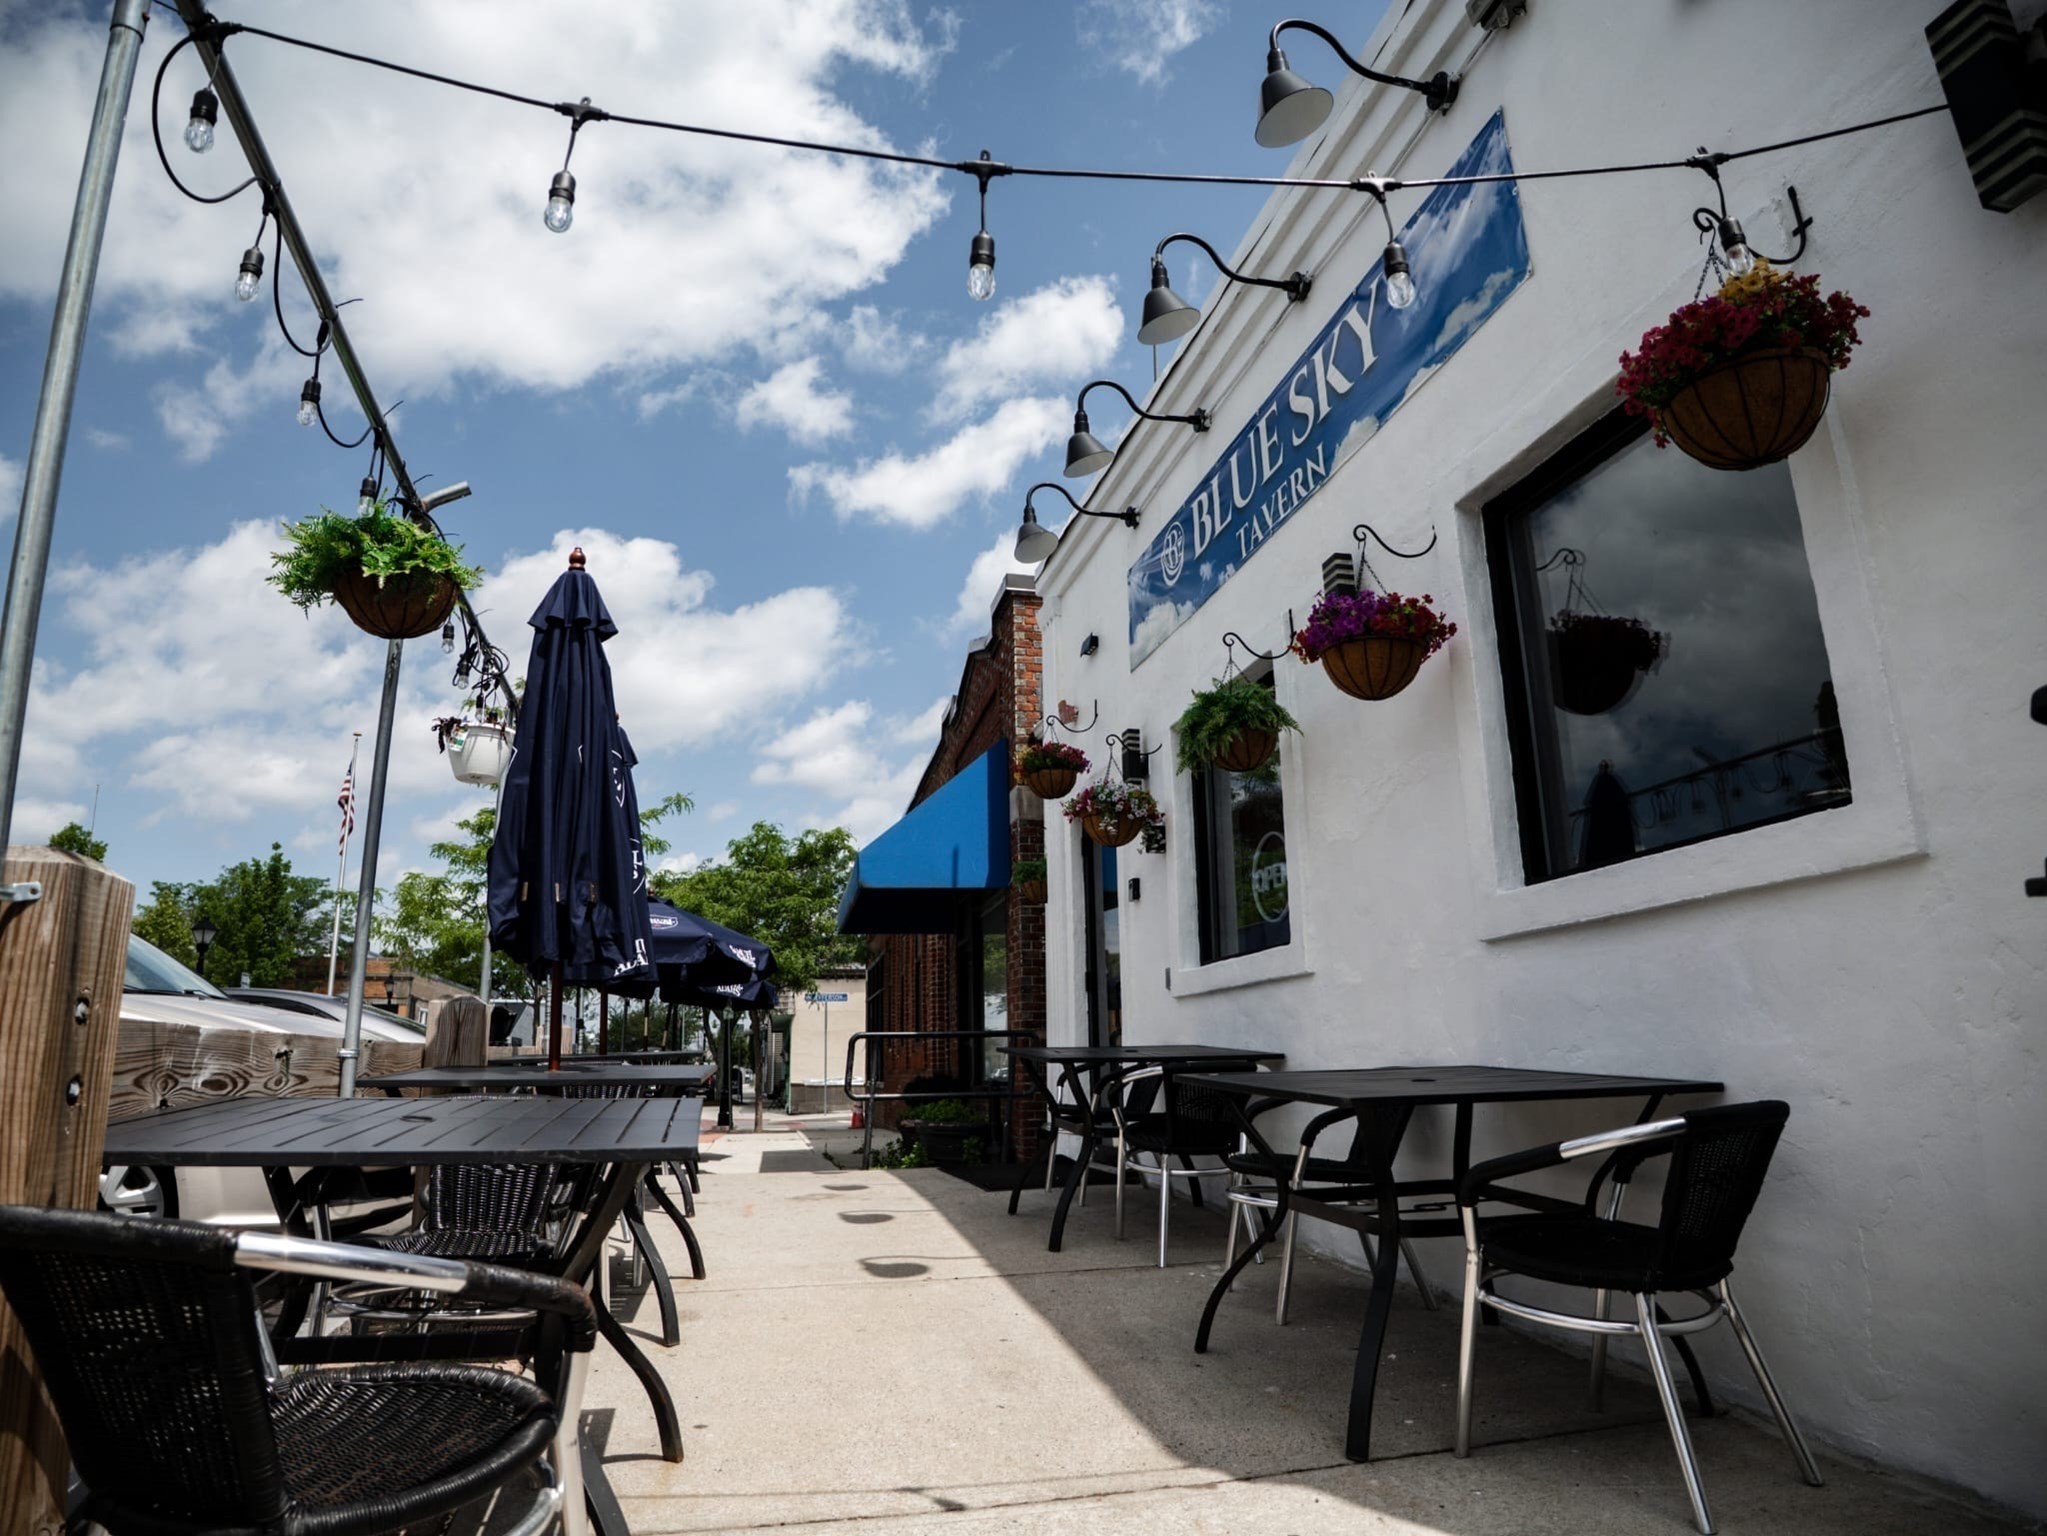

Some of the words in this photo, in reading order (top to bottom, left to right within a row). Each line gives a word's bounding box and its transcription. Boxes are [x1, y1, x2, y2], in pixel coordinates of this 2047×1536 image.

[1190, 402, 1284, 560] BLUE
[1288, 271, 1384, 447] SKY
[1235, 443, 1329, 559] TAVERN
